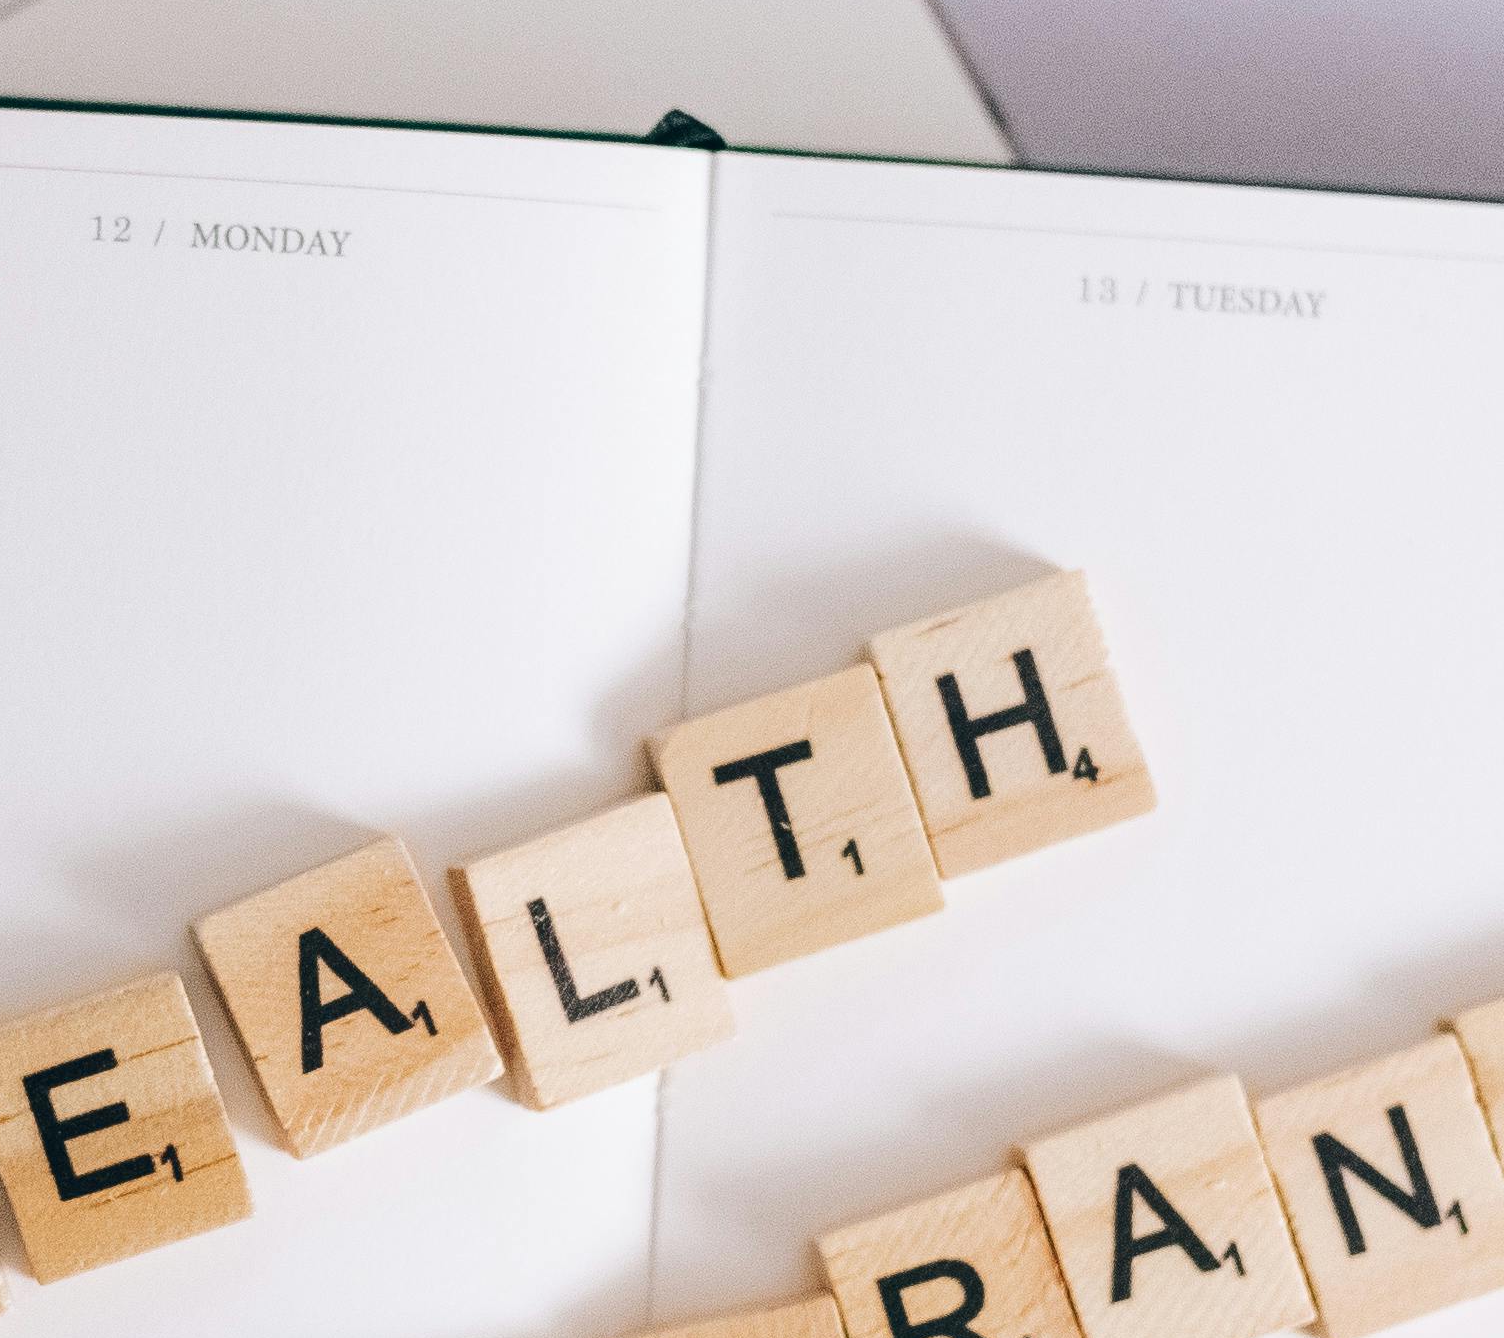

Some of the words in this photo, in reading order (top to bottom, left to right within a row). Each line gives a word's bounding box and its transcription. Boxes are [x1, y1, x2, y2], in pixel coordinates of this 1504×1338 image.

[93, 215, 132, 244] 12
[190, 222, 350, 258] MONDAY
[1080, 276, 1118, 304] 13
[1169, 282, 1326, 319] TUESDAY
